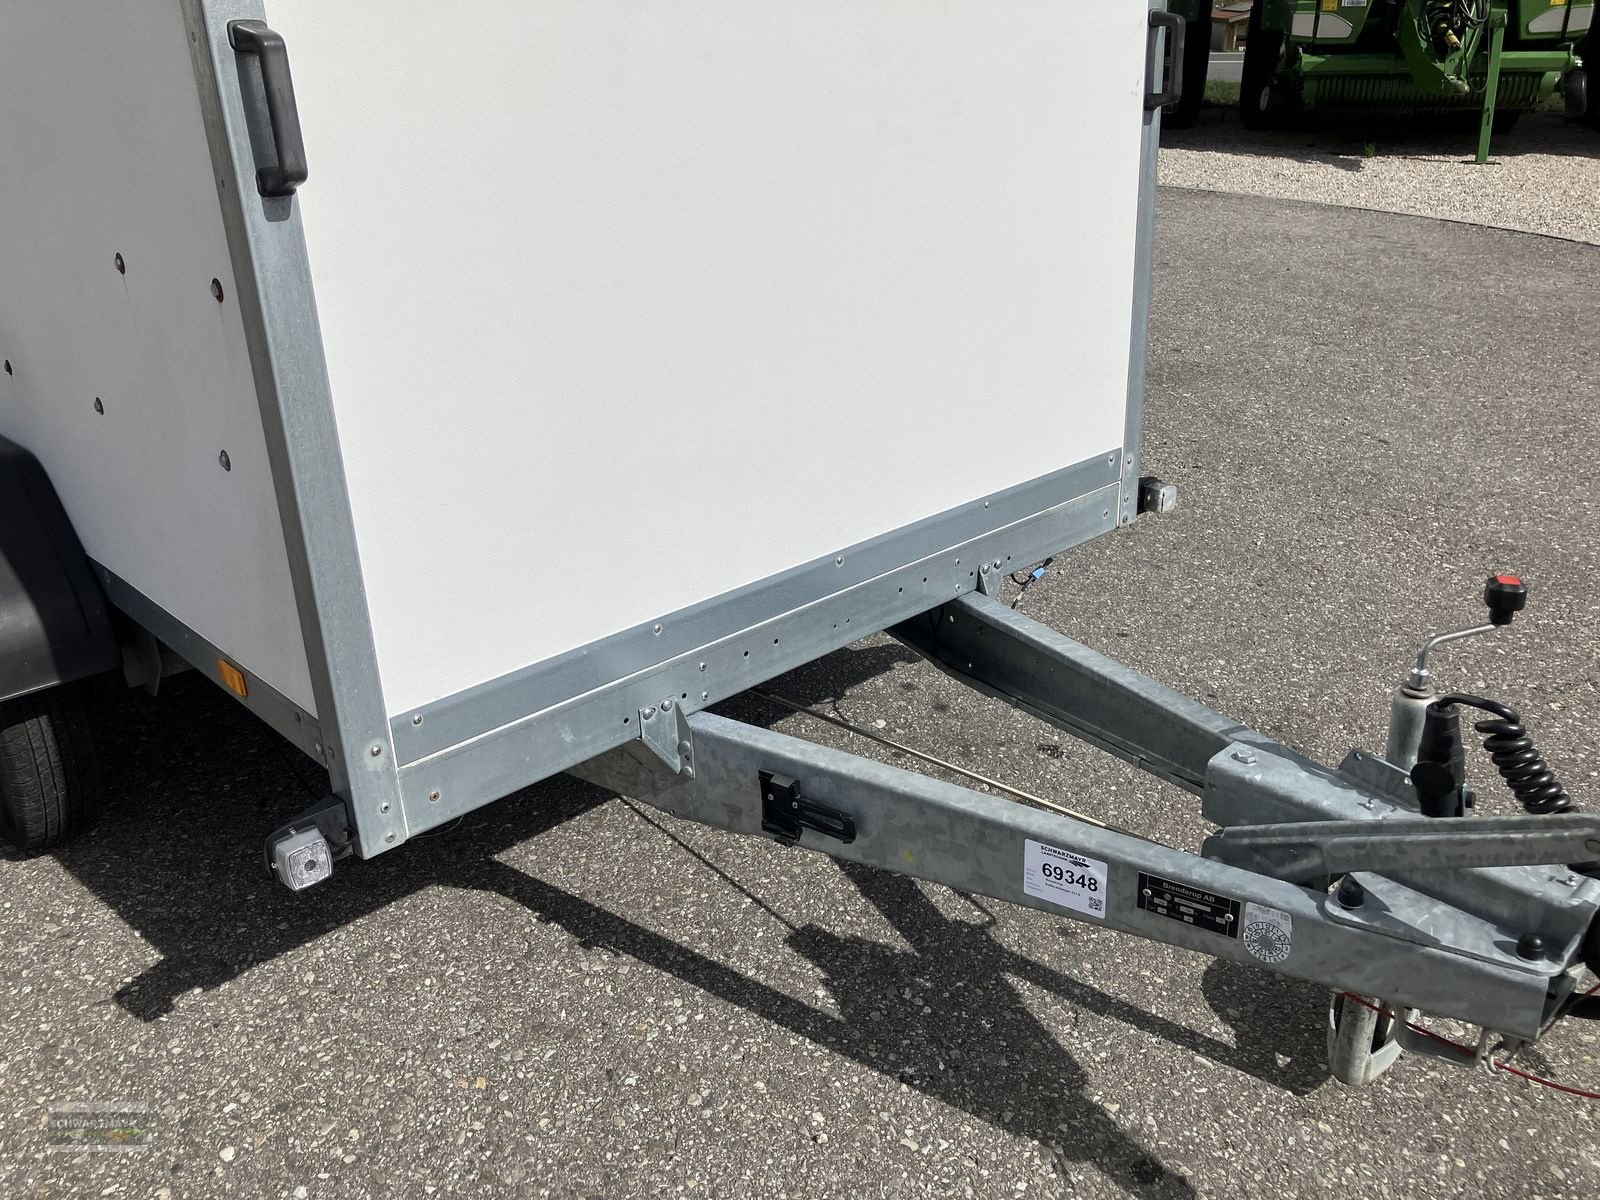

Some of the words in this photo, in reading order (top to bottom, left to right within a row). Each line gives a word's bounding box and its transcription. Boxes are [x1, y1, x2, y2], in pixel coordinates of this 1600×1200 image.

[1040, 845, 1087, 863] SCHWARZMAYR
[1042, 863, 1098, 892] 69348
[1162, 881, 1202, 899] Brenderup
[1203, 895, 1215, 903] AB
